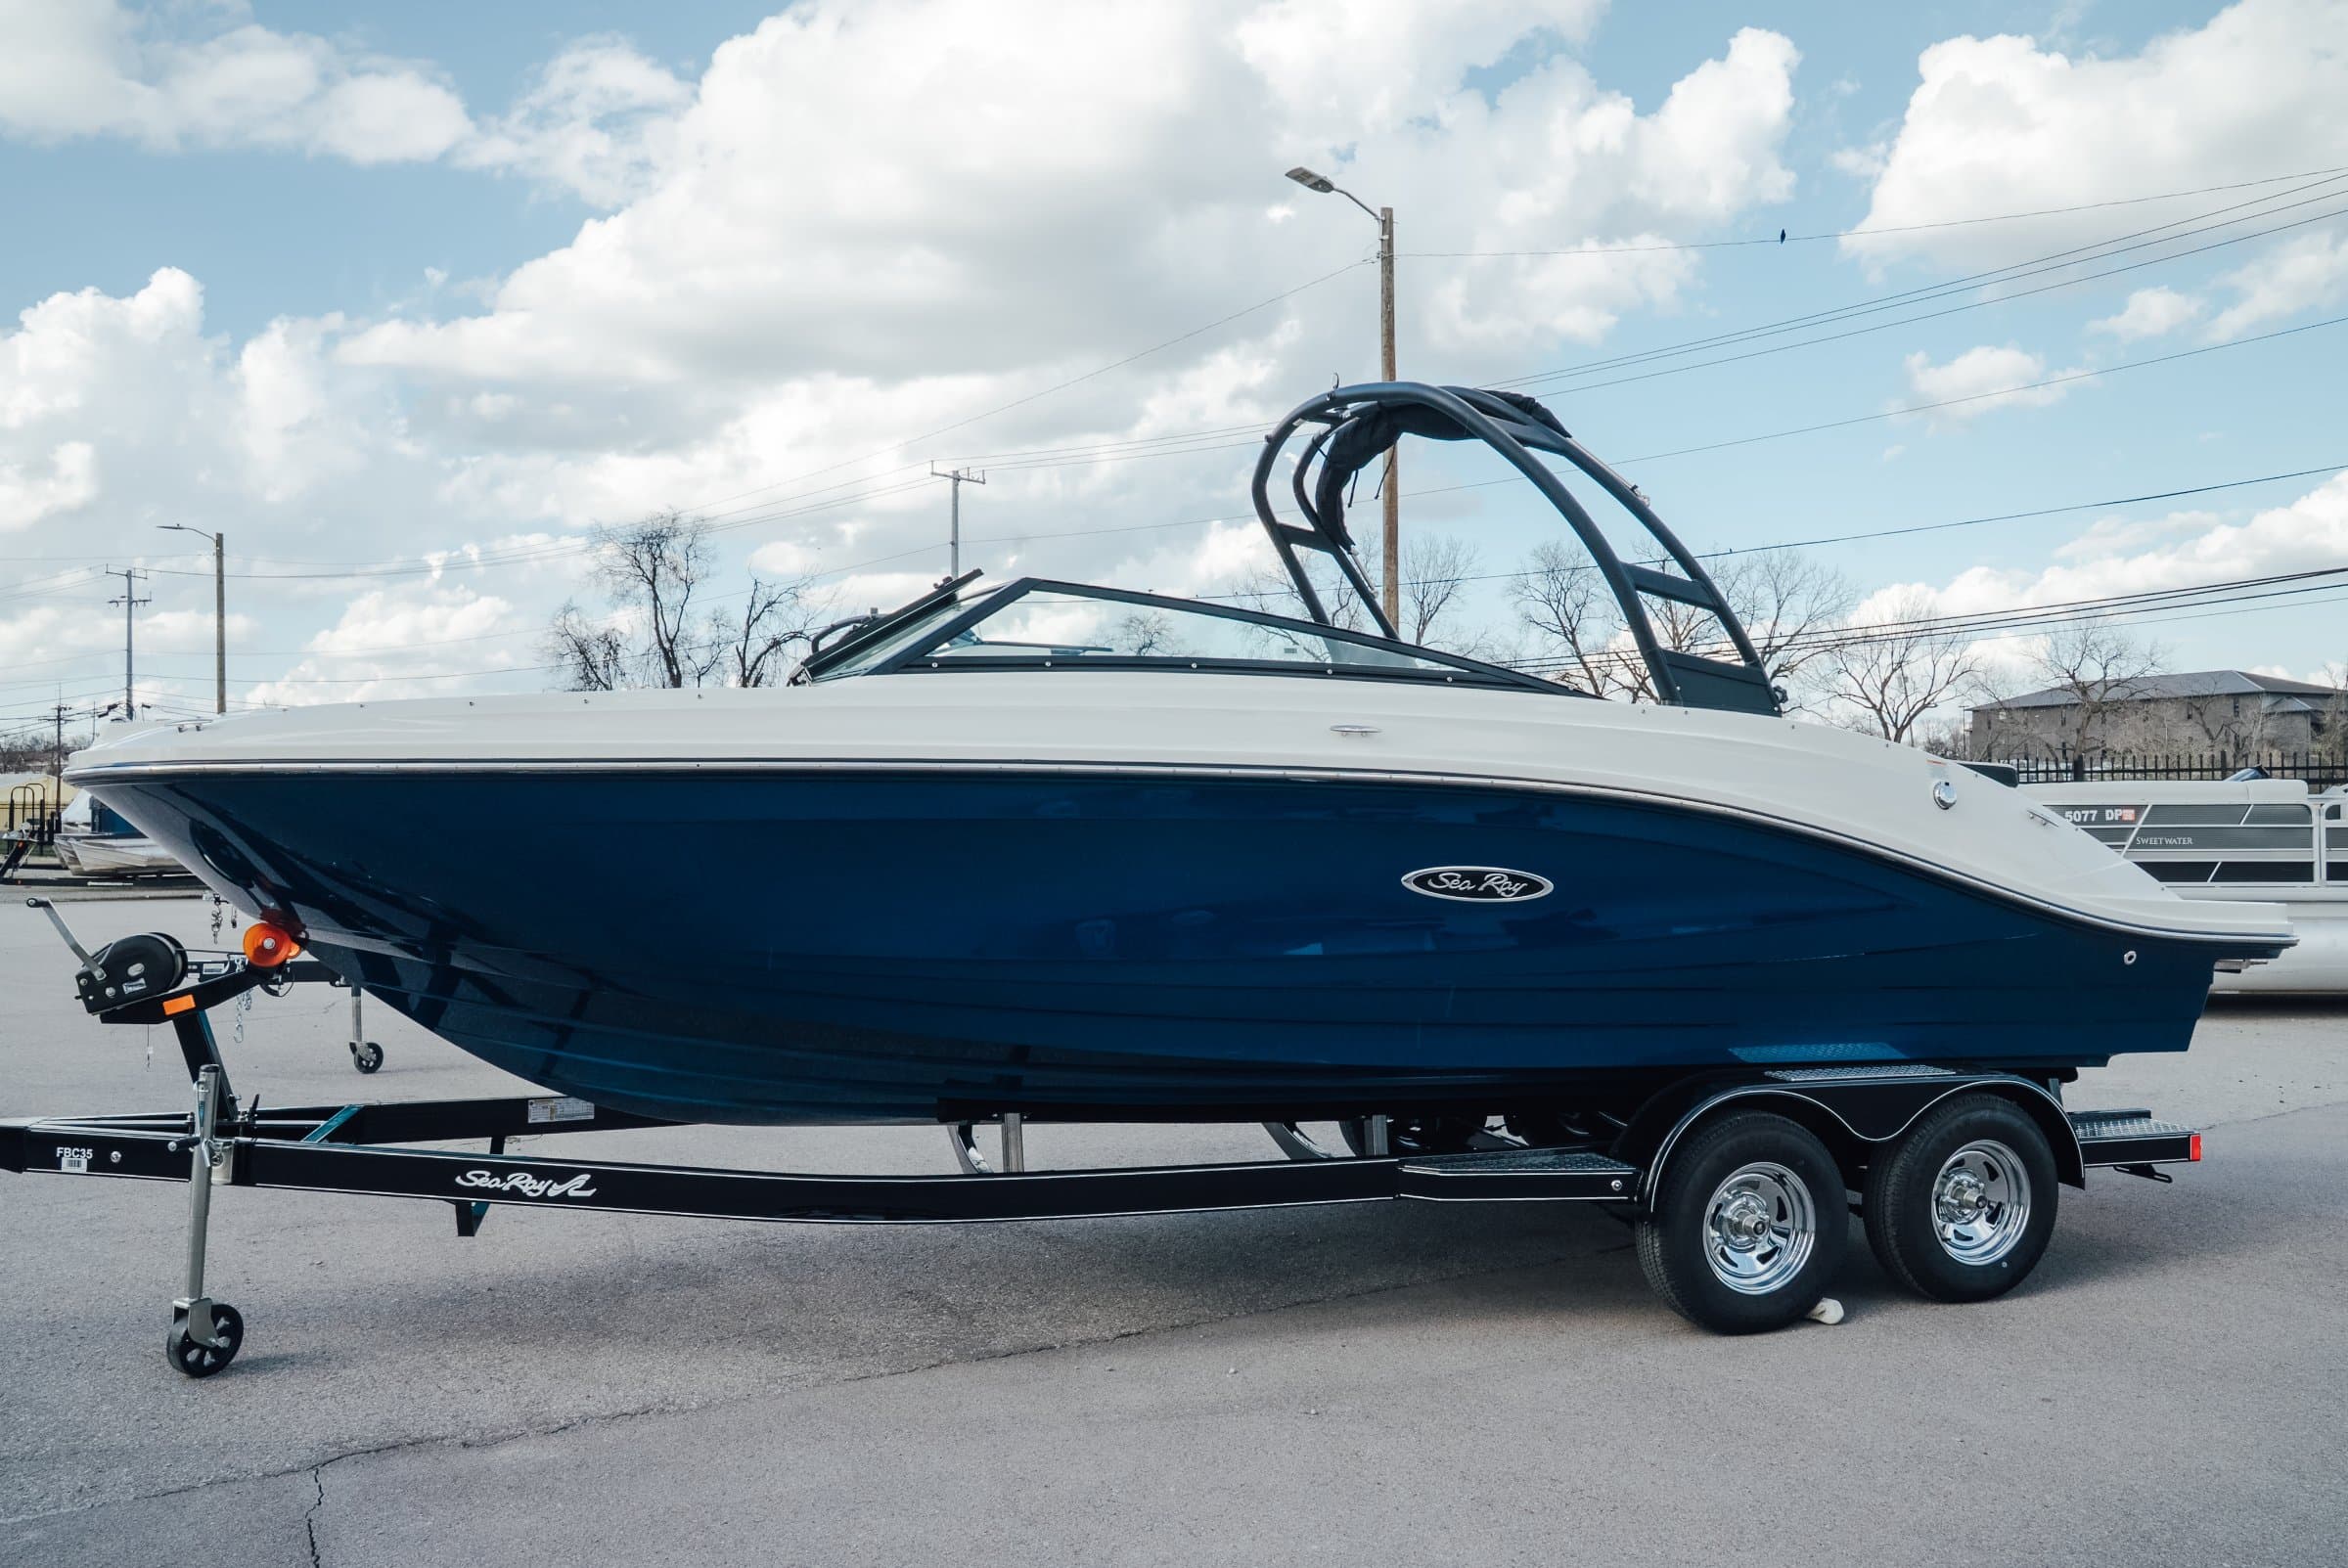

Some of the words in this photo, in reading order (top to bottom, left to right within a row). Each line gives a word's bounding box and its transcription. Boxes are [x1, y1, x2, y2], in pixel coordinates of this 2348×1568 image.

[2064, 809, 2099, 823] 5077
[2104, 808, 2122, 821] DP
[1427, 873, 1476, 891] Sea
[1478, 873, 1528, 898] Ray
[56, 1146, 93, 1159] FBC35
[455, 1170, 506, 1187] Sea
[502, 1173, 554, 1196] Ray
